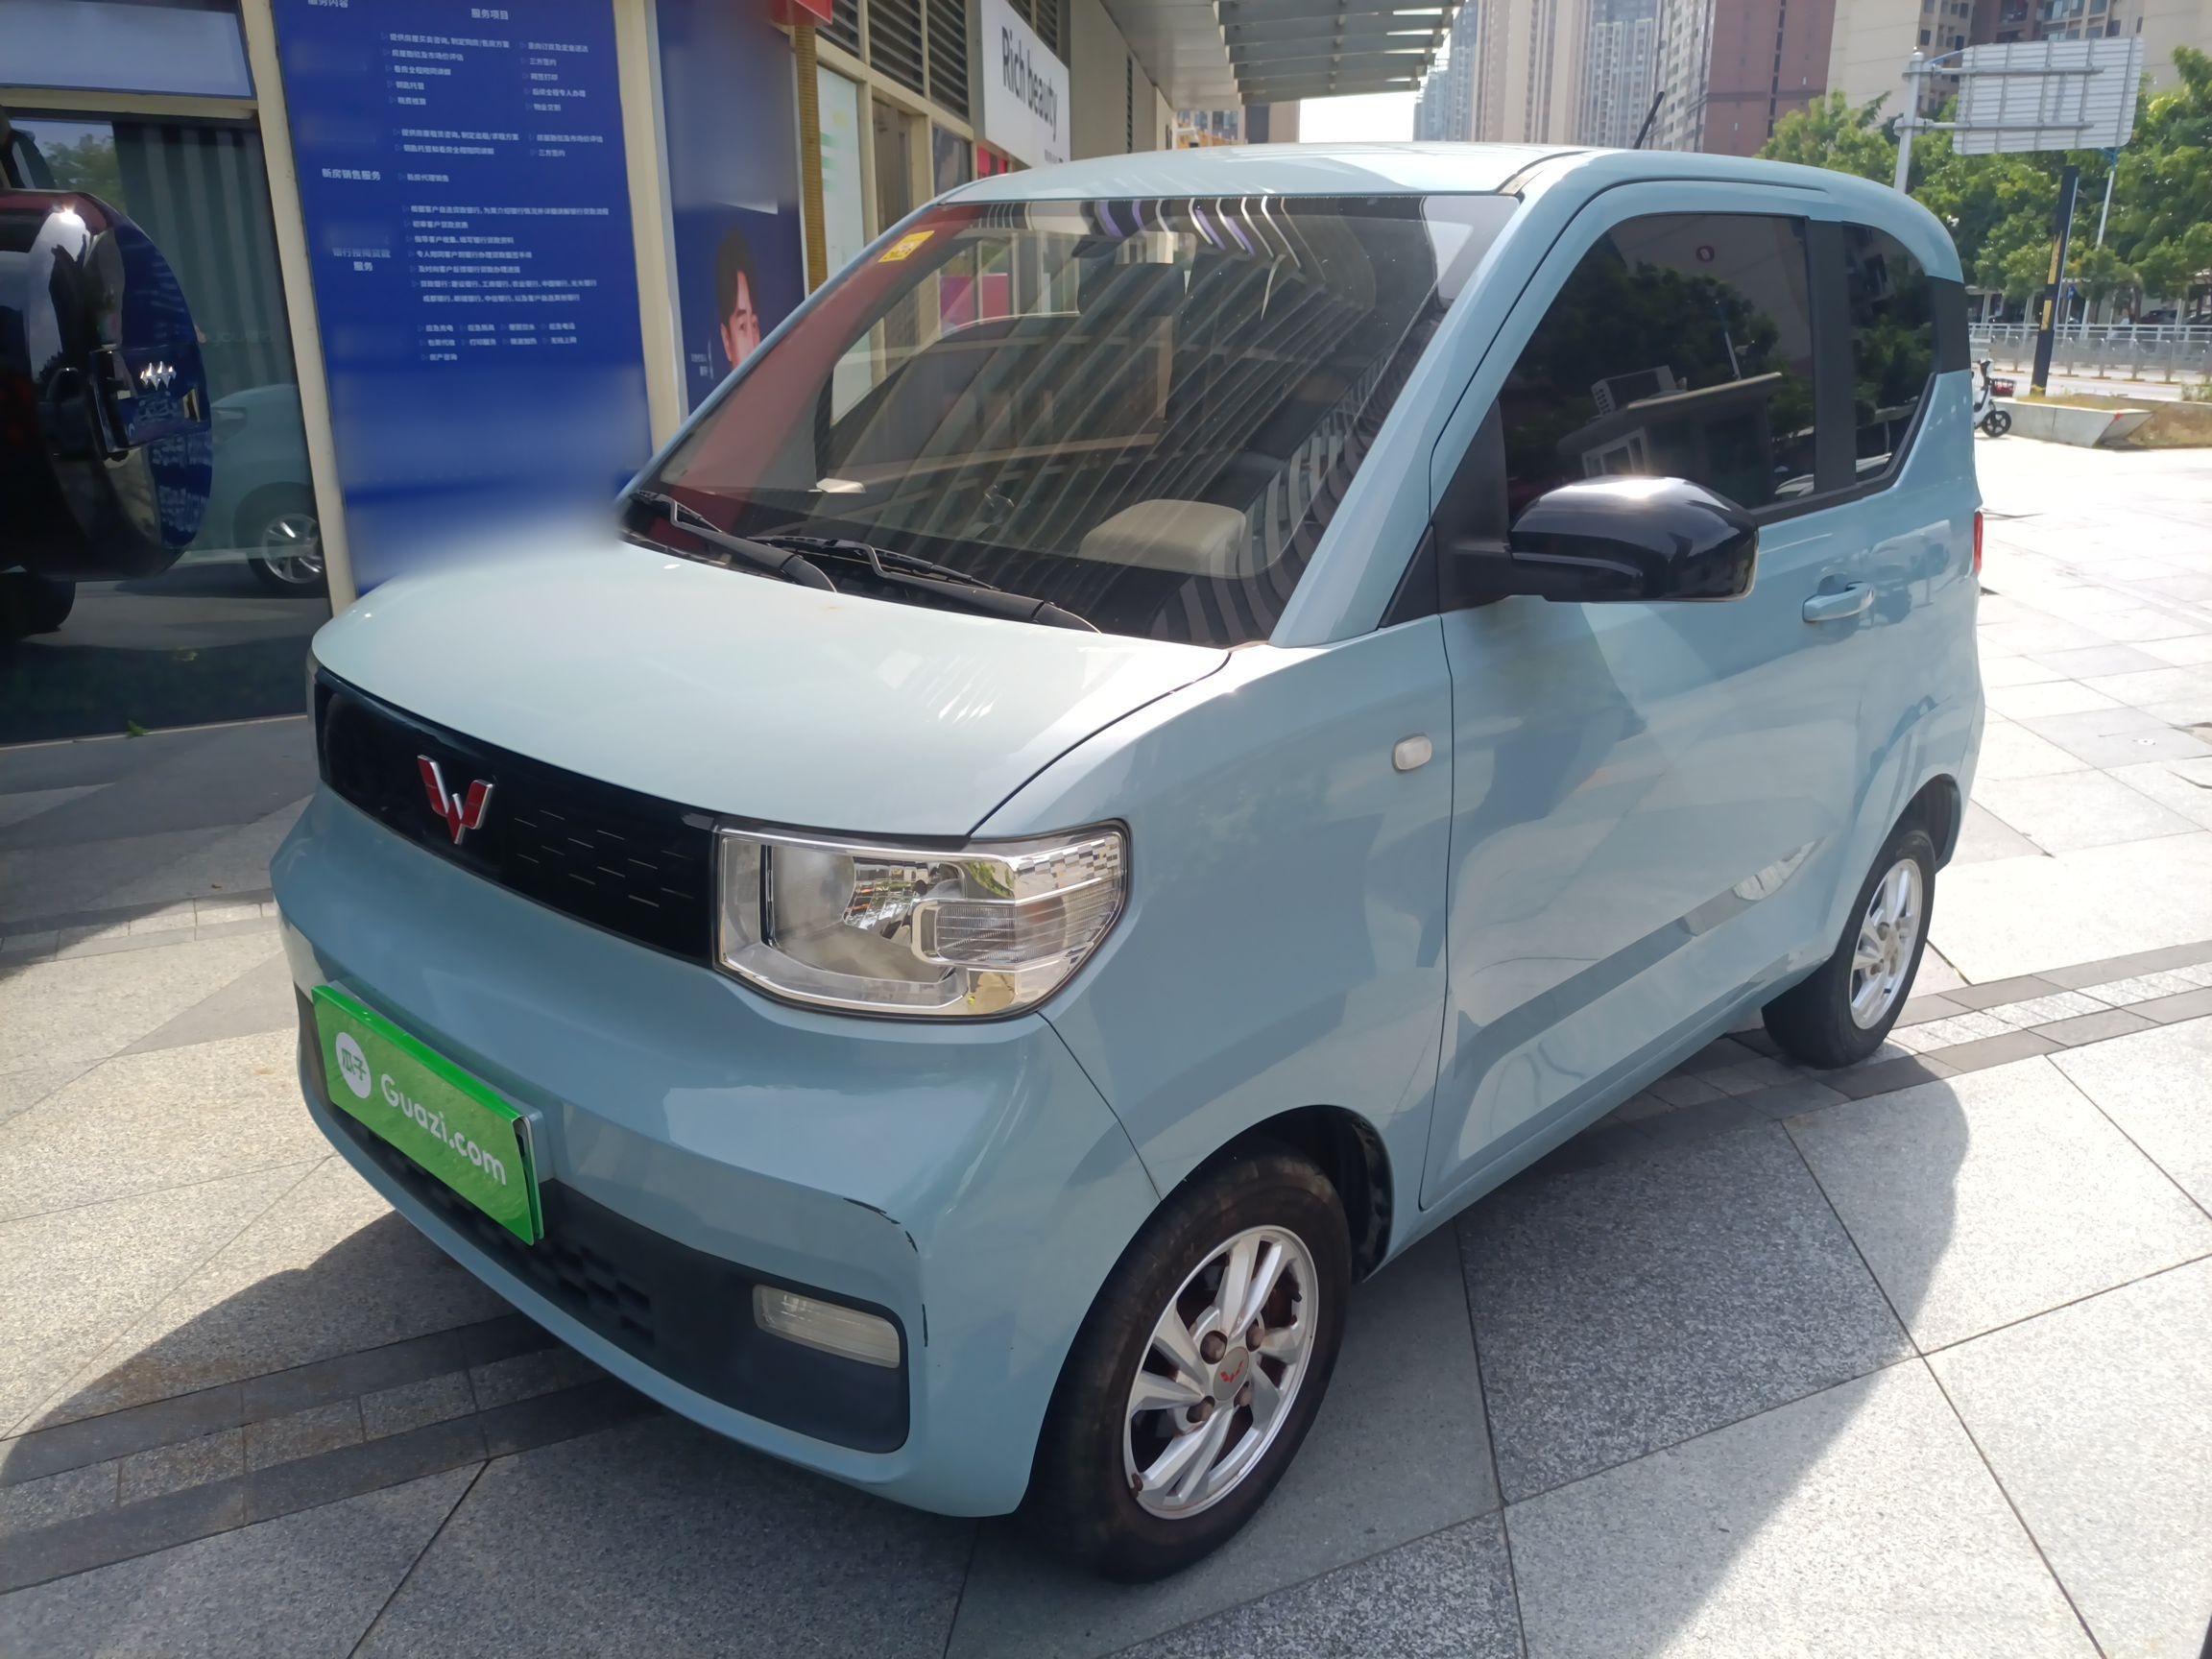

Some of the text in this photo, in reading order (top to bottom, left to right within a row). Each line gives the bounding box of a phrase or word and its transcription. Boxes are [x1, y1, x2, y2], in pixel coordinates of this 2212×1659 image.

[470, 8, 509, 20] 服务项目
[1001, 26, 1025, 104] Rich
[1026, 49, 1057, 142] beauty
[322, 168, 381, 181] 新房销售服务
[352, 260, 374, 272] 服务
[341, 1047, 367, 1081] 瓜子
[380, 1073, 507, 1186] Guazi.com
